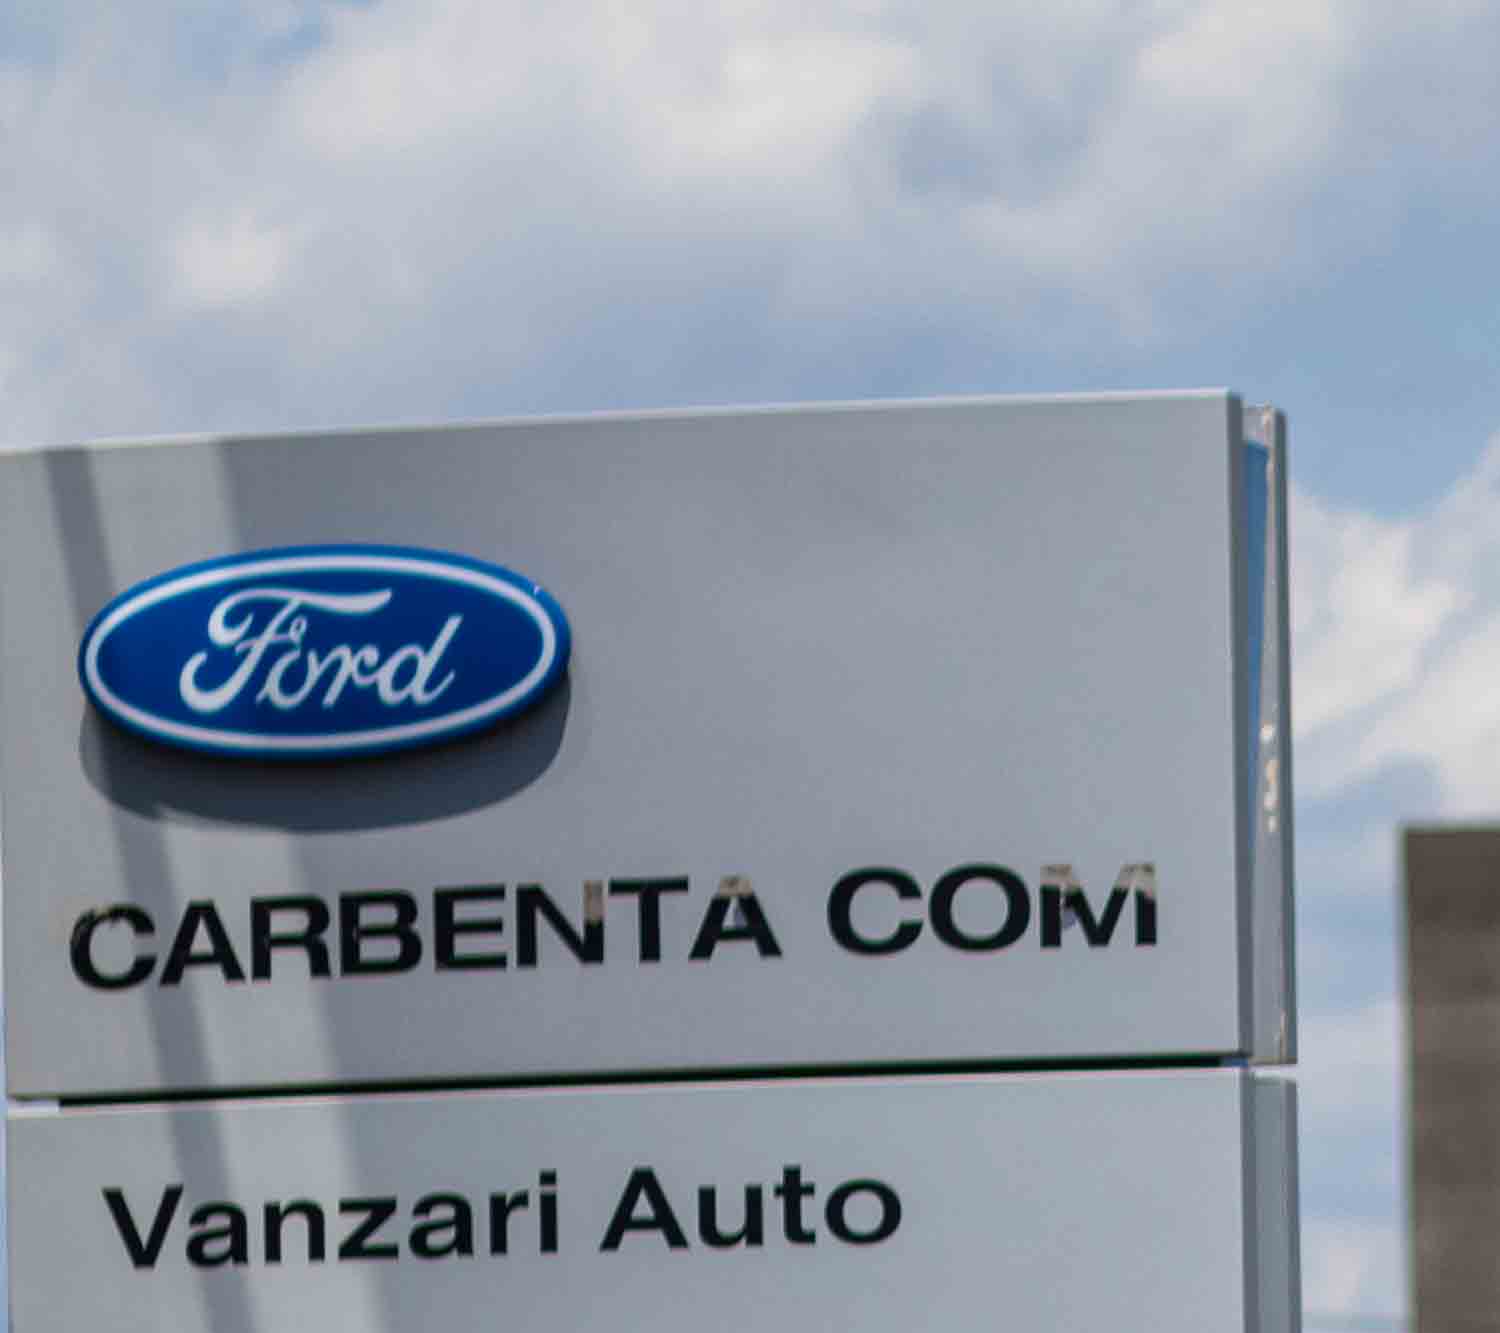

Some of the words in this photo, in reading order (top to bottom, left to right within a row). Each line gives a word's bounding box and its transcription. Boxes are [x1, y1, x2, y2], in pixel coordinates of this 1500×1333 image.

[178, 586, 461, 712] Ford
[68, 872, 783, 992] CARBENTA
[826, 862, 1159, 957] COM
[103, 1168, 559, 1269] Vanzari
[599, 1164, 903, 1252] Auto
